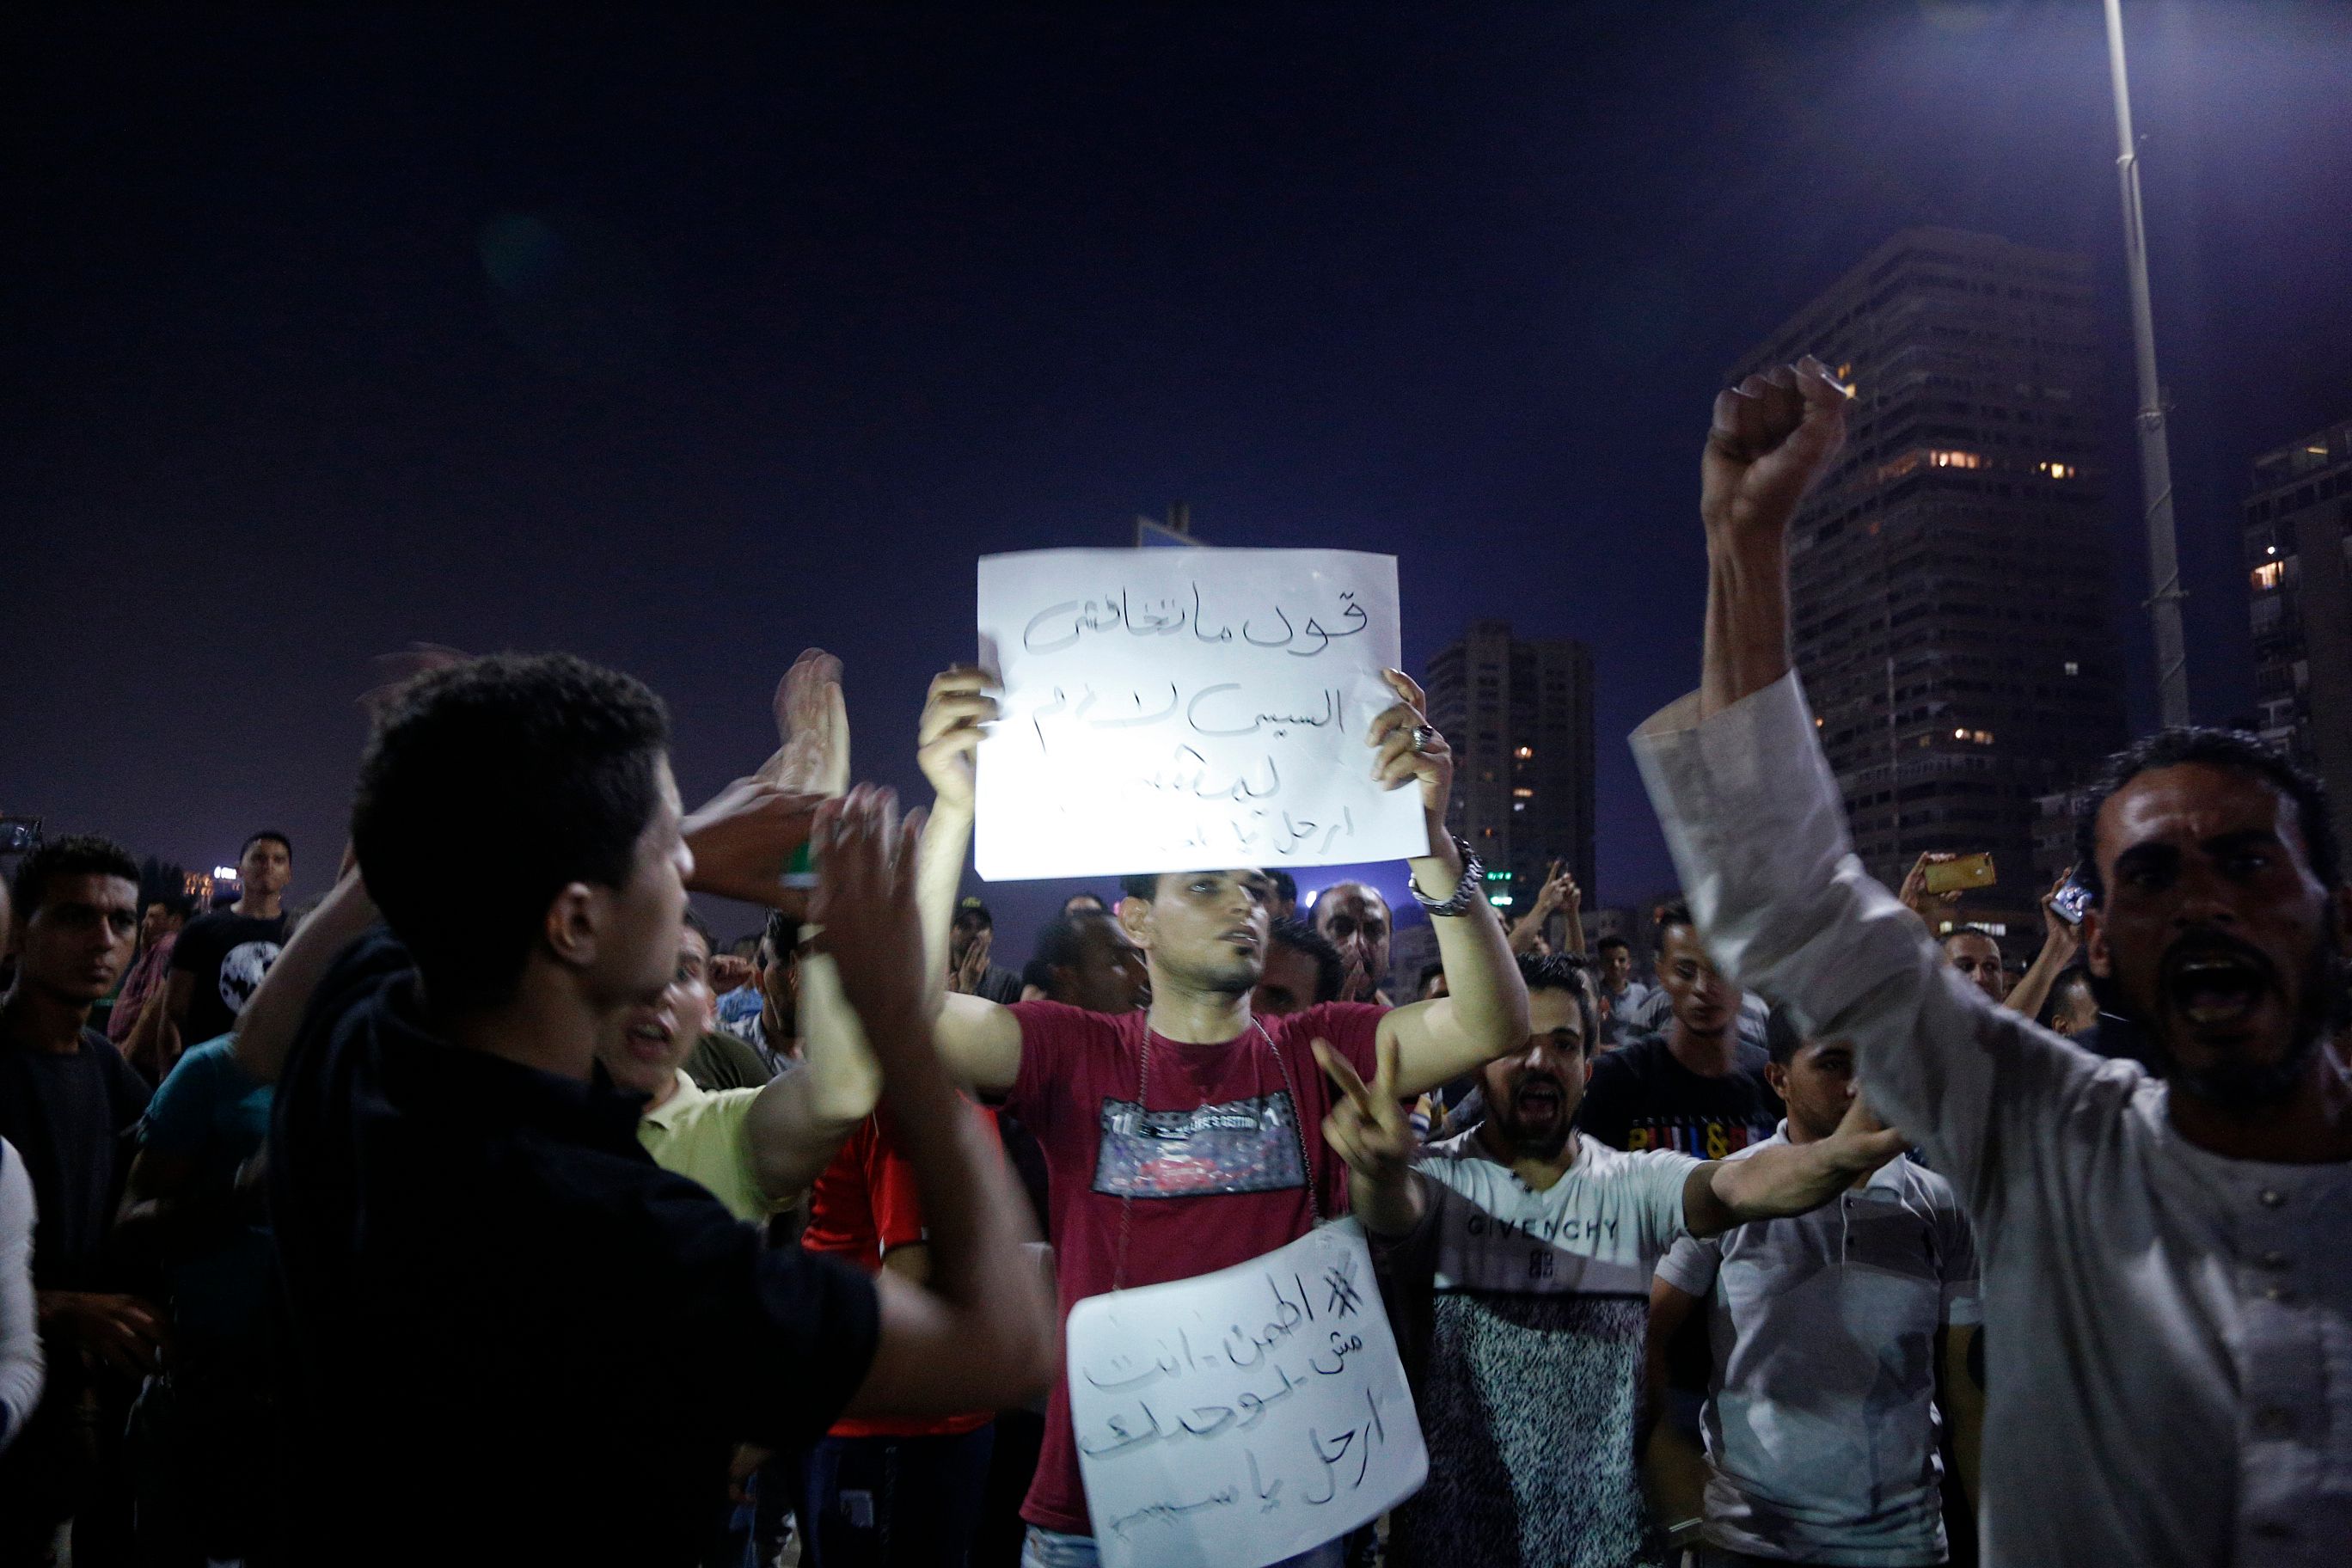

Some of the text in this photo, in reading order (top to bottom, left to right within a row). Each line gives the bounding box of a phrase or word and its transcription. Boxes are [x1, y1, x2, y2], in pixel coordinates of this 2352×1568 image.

[1243, 591, 1368, 657] قول
[1272, 805, 1355, 855] ارحل
[1467, 1217, 1620, 1242] GIVENCHY
[1303, 1387, 1385, 1505] ارحل
[1245, 1449, 1284, 1514] يا
